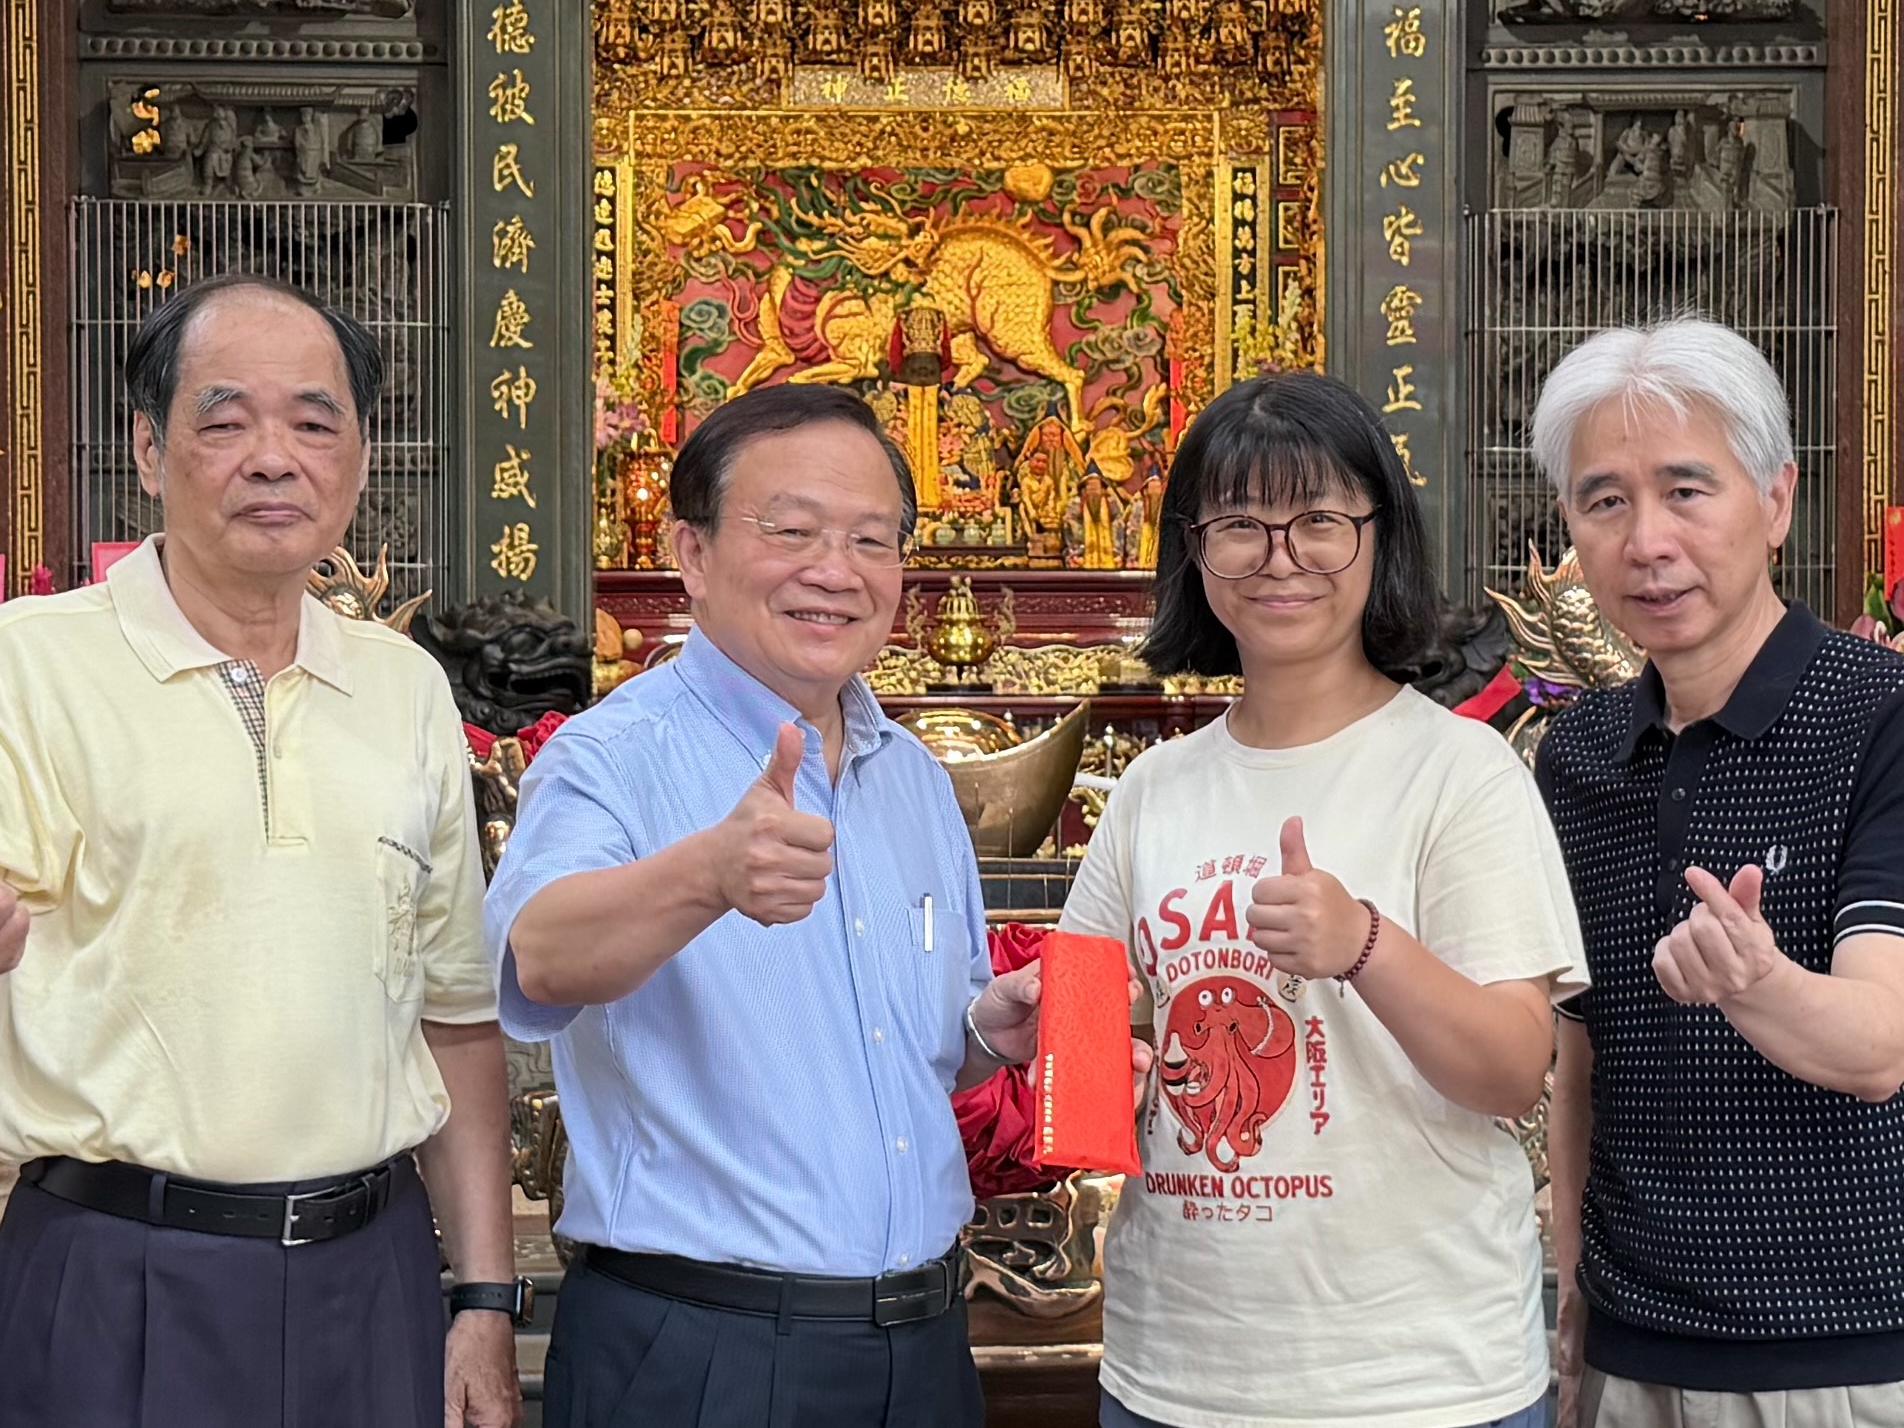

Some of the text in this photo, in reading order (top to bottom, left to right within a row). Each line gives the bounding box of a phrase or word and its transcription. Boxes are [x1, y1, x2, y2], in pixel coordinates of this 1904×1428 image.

[1136, 879, 1259, 978] OSA
[1165, 947, 1274, 983] DOTONBORI
[1304, 1015, 1331, 1136] 大阪エリア
[1146, 1173, 1334, 1200] DRUNKEN OCTOPUS
